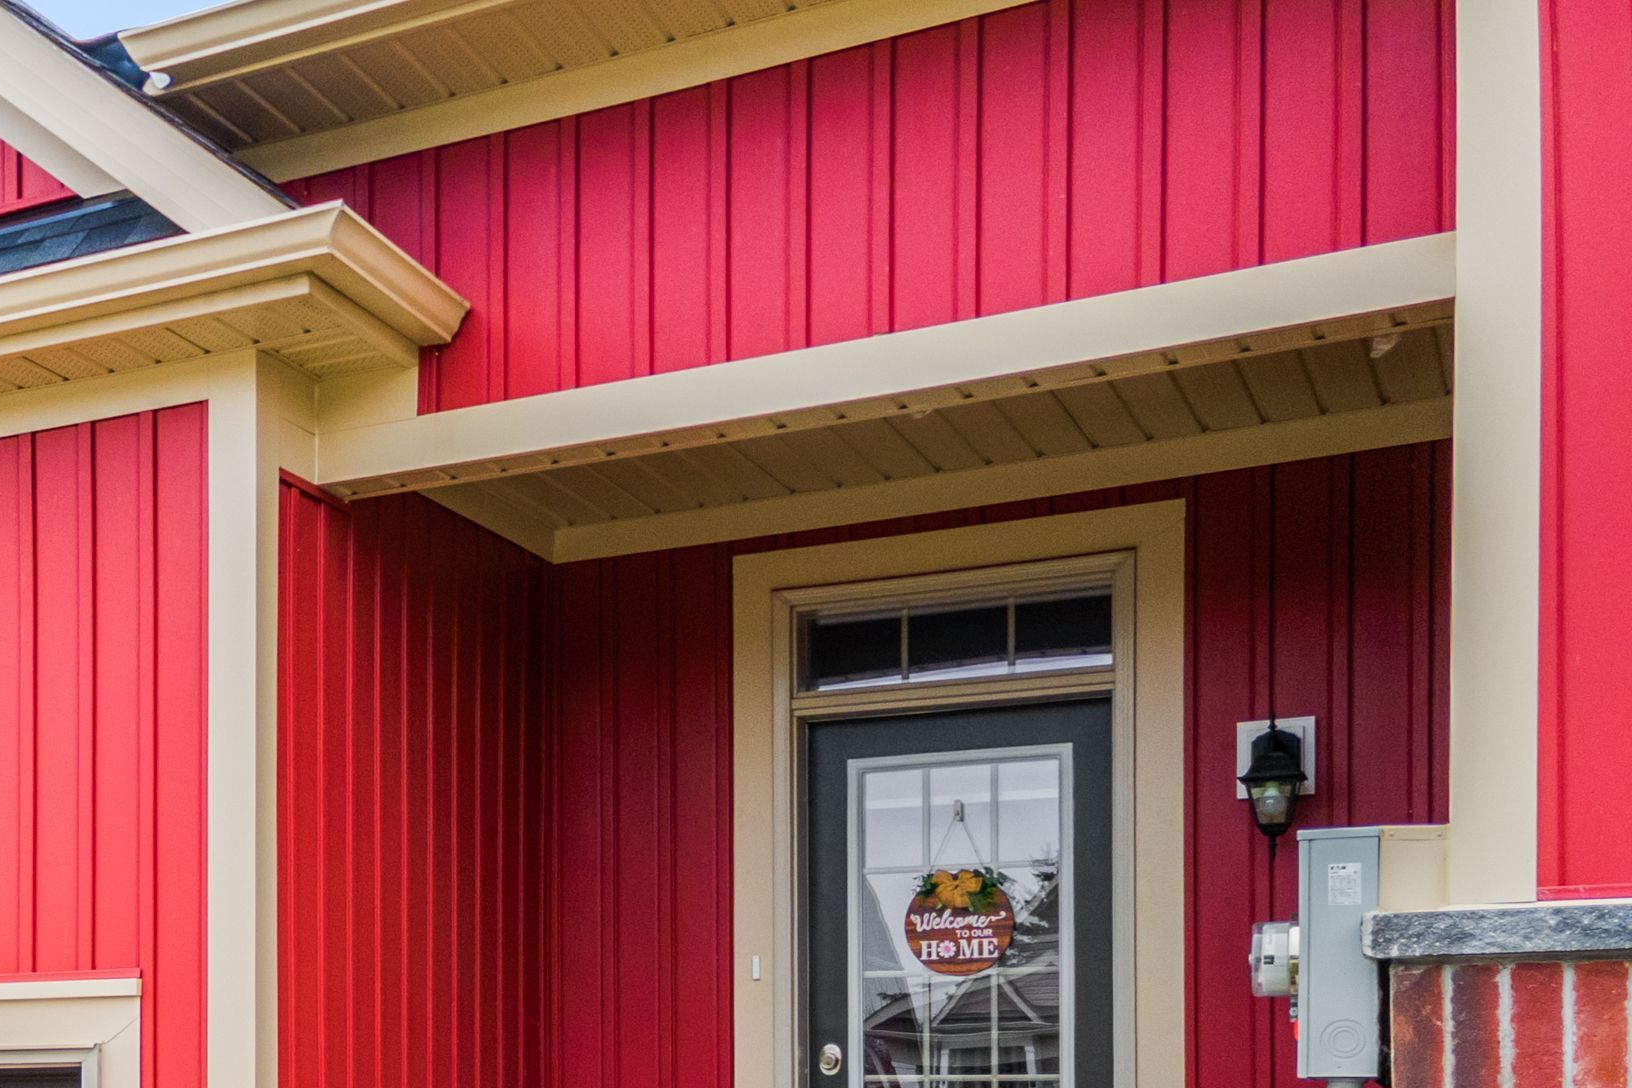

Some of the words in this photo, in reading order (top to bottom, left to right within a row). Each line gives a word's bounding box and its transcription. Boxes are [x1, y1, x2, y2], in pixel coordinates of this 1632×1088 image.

[910, 908, 1006, 932] Welcome
[956, 930, 970, 938] TO
[971, 929, 993, 937] OUR
